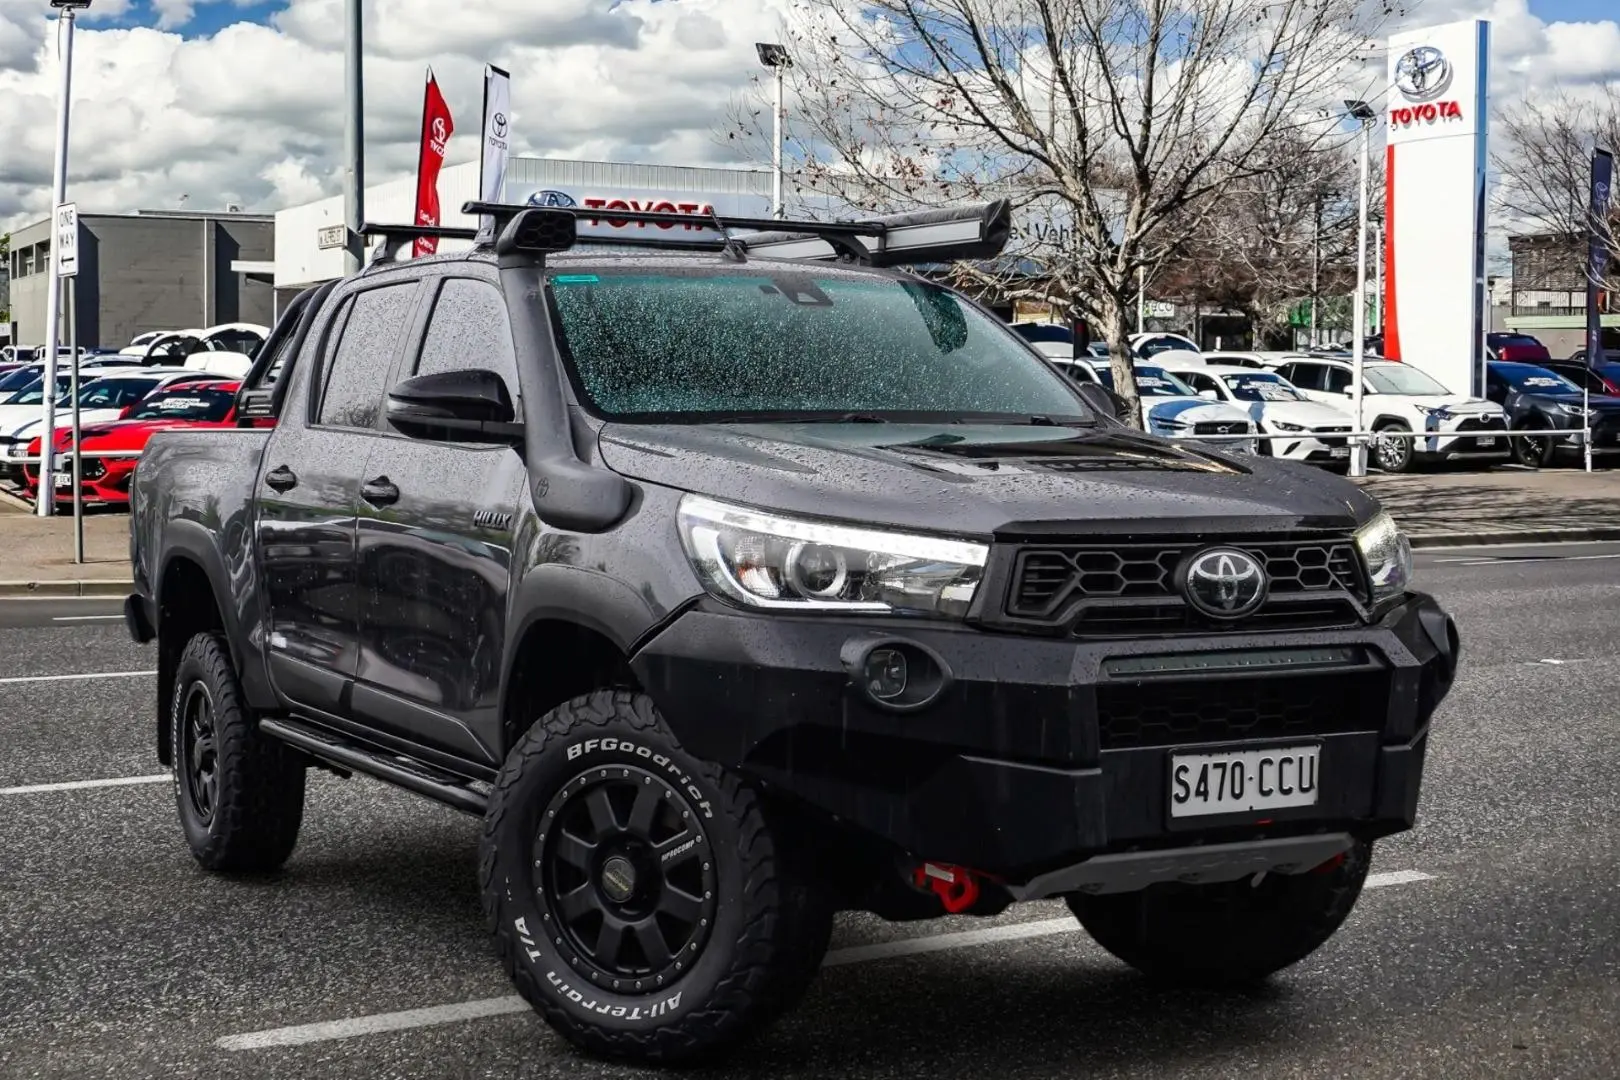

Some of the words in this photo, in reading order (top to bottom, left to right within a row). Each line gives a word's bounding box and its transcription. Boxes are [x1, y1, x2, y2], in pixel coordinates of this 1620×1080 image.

[1390, 101, 1463, 125] TOYOTA
[59, 209, 74, 228] ONE
[59, 231, 75, 249] WAY
[473, 510, 512, 530] HILUX
[566, 737, 713, 819] BFGoodrich
[514, 916, 542, 964] T/A
[546, 971, 682, 1021] All-Terrain
